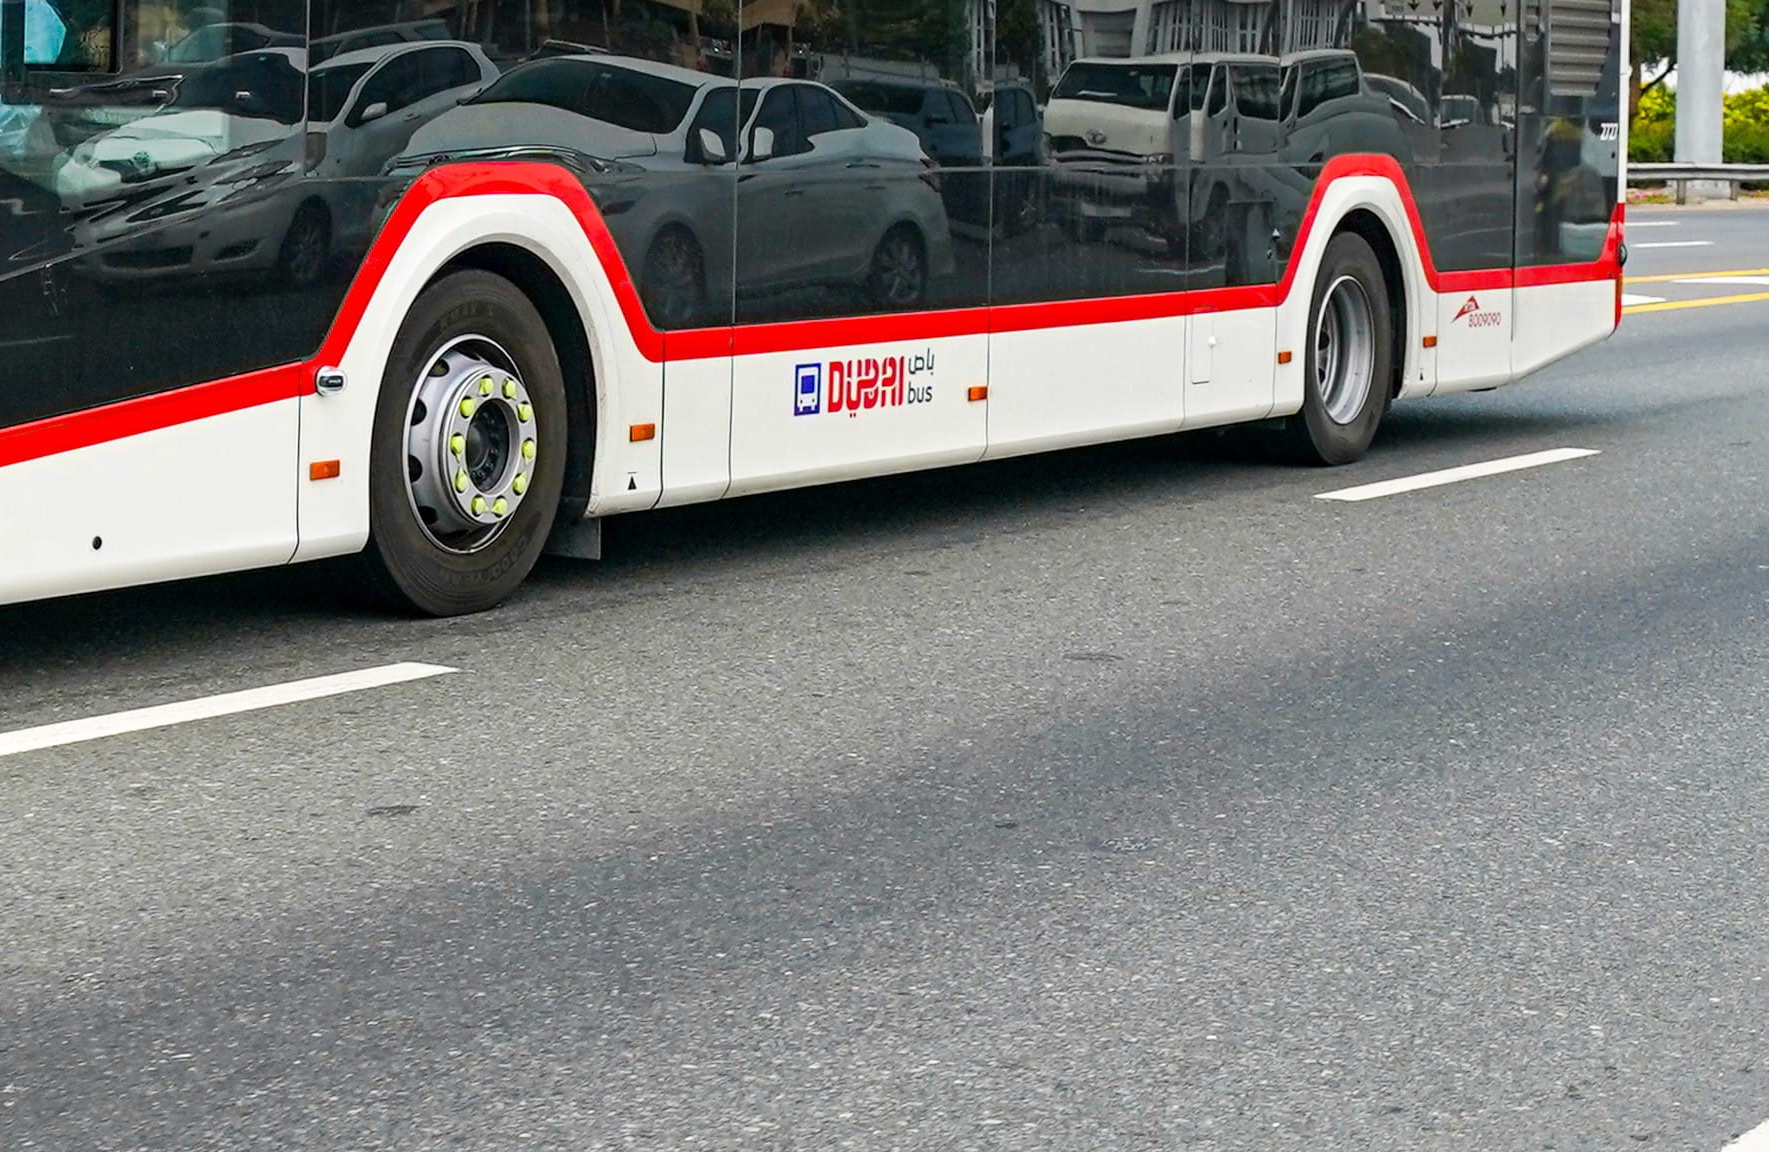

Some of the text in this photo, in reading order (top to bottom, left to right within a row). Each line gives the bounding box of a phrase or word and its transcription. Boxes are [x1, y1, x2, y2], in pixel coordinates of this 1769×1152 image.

[908, 347, 935, 376] باص
[828, 355, 905, 418] DUBAI
[907, 381, 934, 405] bus
